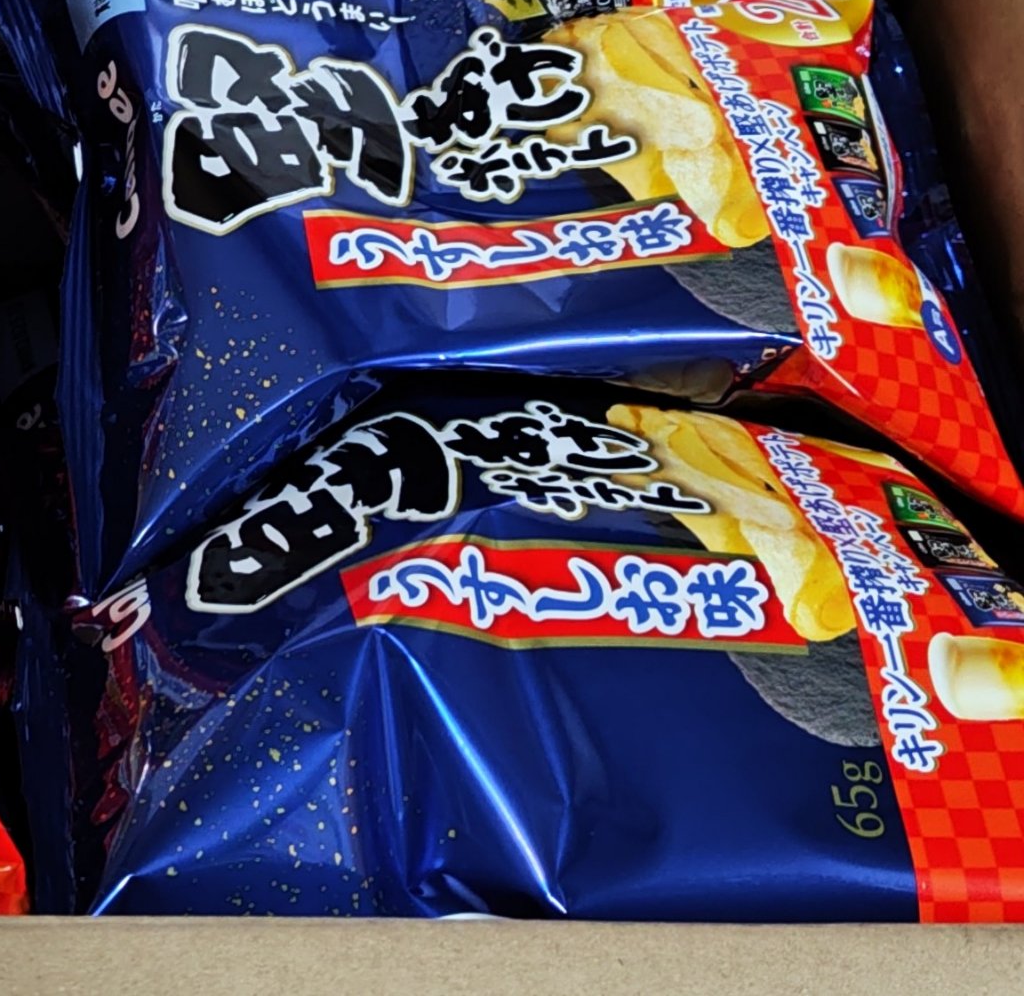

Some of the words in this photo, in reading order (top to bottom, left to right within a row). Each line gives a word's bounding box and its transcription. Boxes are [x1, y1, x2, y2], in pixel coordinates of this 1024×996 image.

[328, 202, 695, 284] うすしお味
[368, 544, 770, 639] うすしお味
[829, 760, 887, 839] 65g
